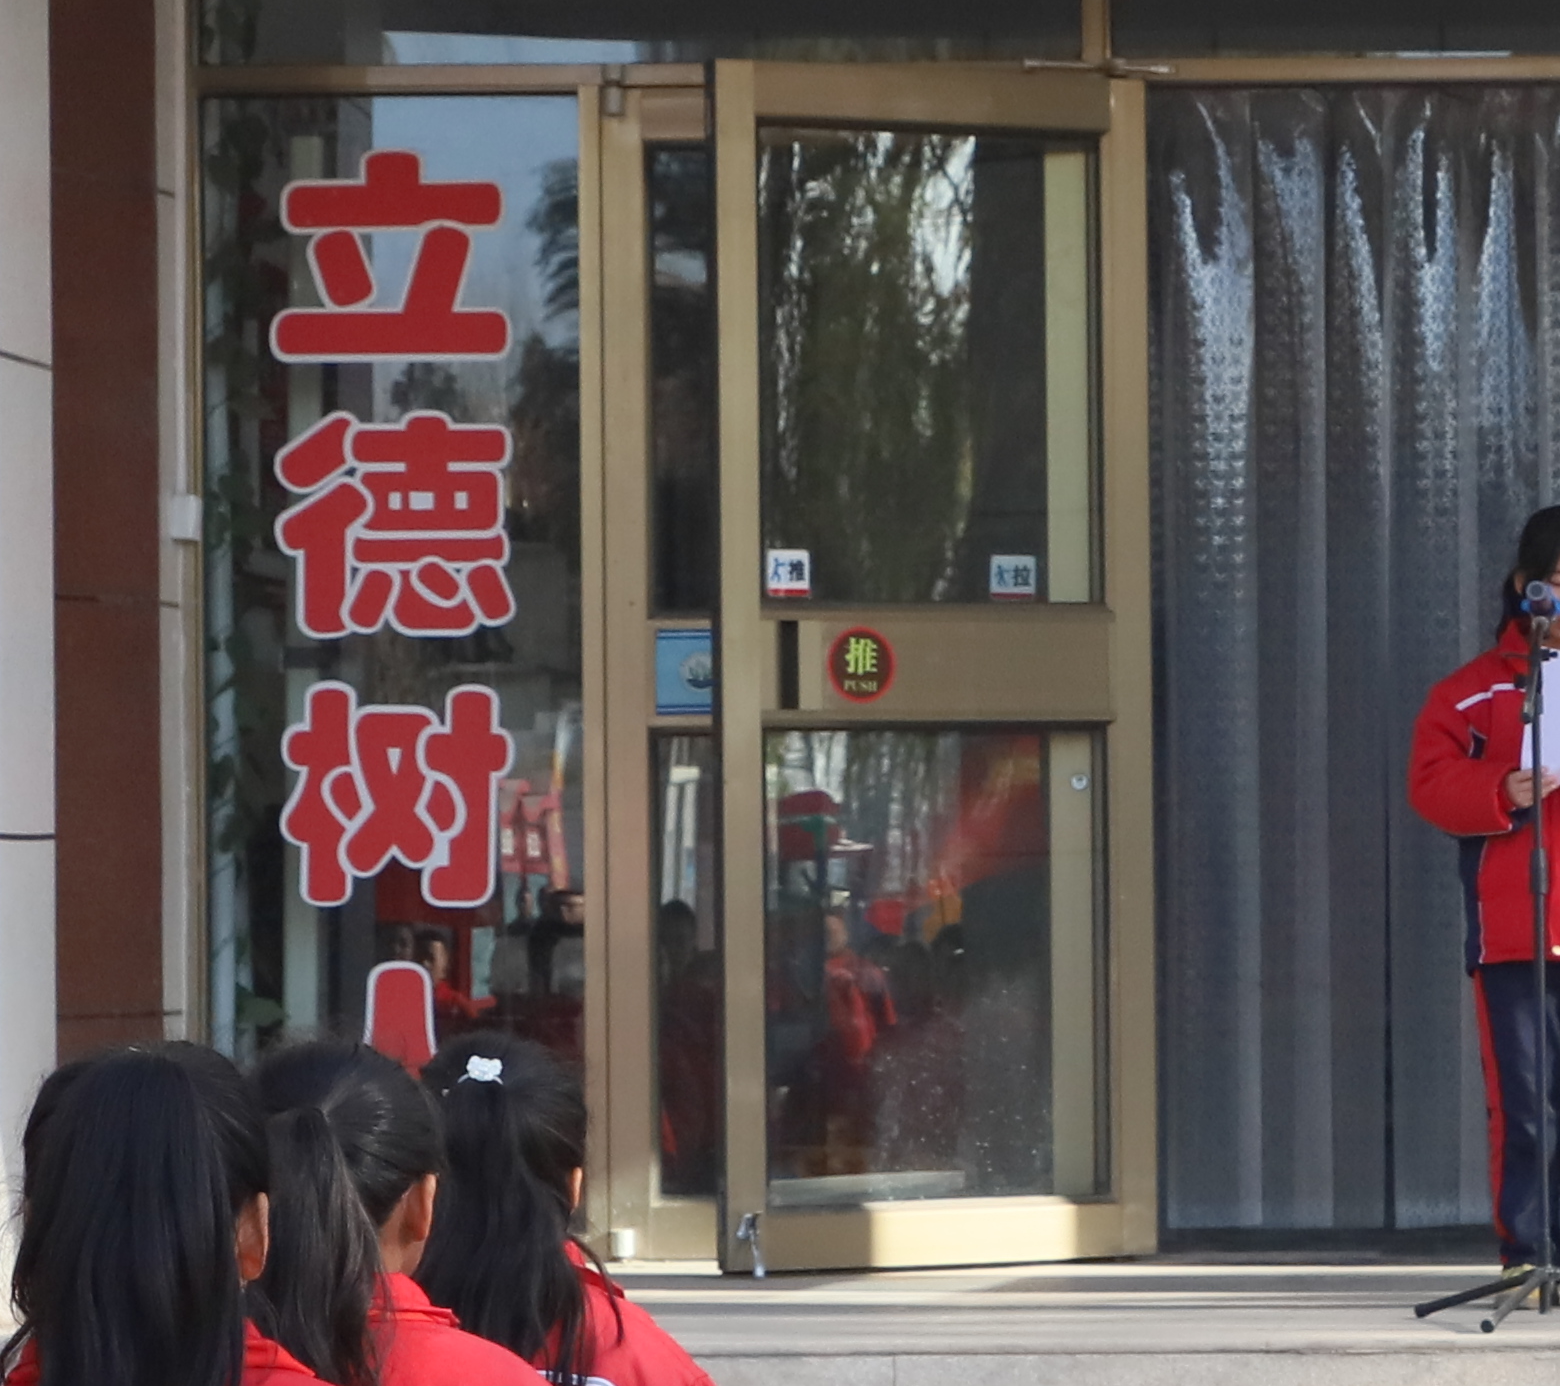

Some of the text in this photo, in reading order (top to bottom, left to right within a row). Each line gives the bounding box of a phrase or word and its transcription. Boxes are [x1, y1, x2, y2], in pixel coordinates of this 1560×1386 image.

[788, 560, 806, 582] 推
[1013, 564, 1032, 587] 拉
[844, 636, 879, 675] 推
[843, 679, 879, 692] PUSH
